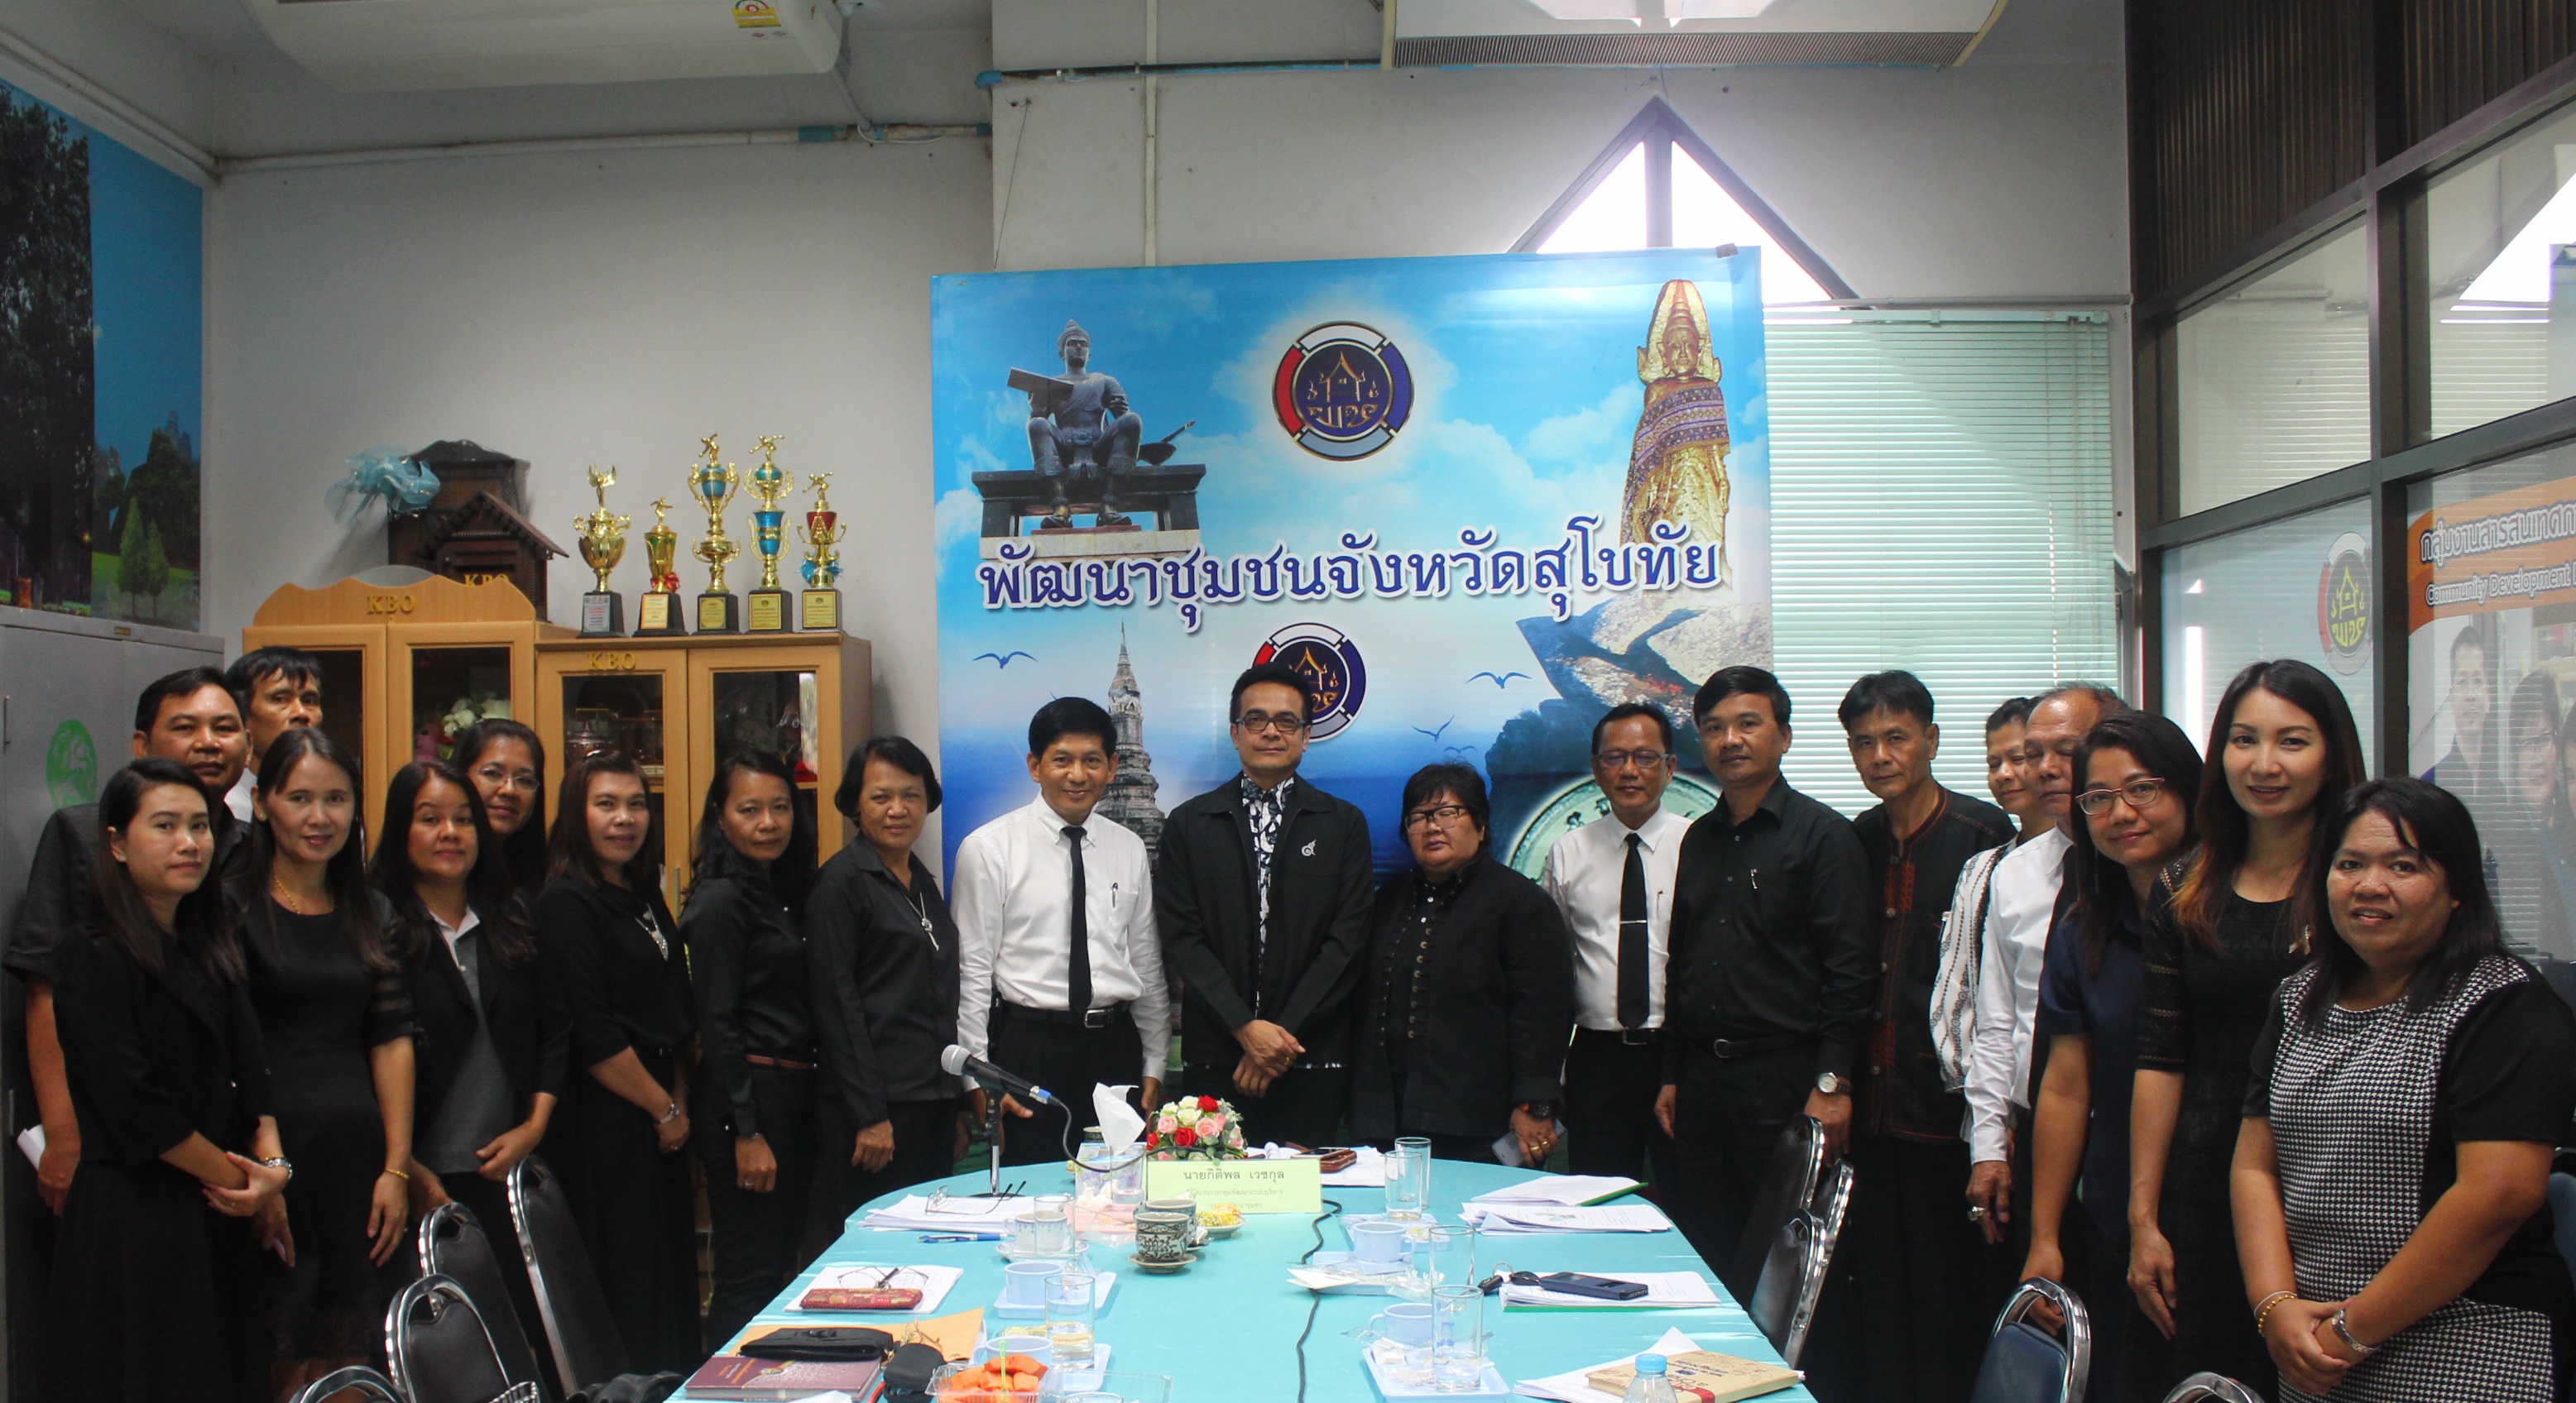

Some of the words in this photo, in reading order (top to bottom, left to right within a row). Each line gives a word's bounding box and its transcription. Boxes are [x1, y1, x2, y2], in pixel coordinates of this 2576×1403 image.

[2420, 502, 2576, 567] กลุ่มงานสารสนเทศก
[977, 514, 1720, 630] พัฒนาชุมชนจังหวัดสุโขทัย
[2425, 575, 2488, 606] Community
[2489, 563, 2571, 598] Development
[367, 595, 416, 614] KBO
[587, 652, 637, 671] KBO
[1250, 1171, 1284, 1182] เวชกุล
